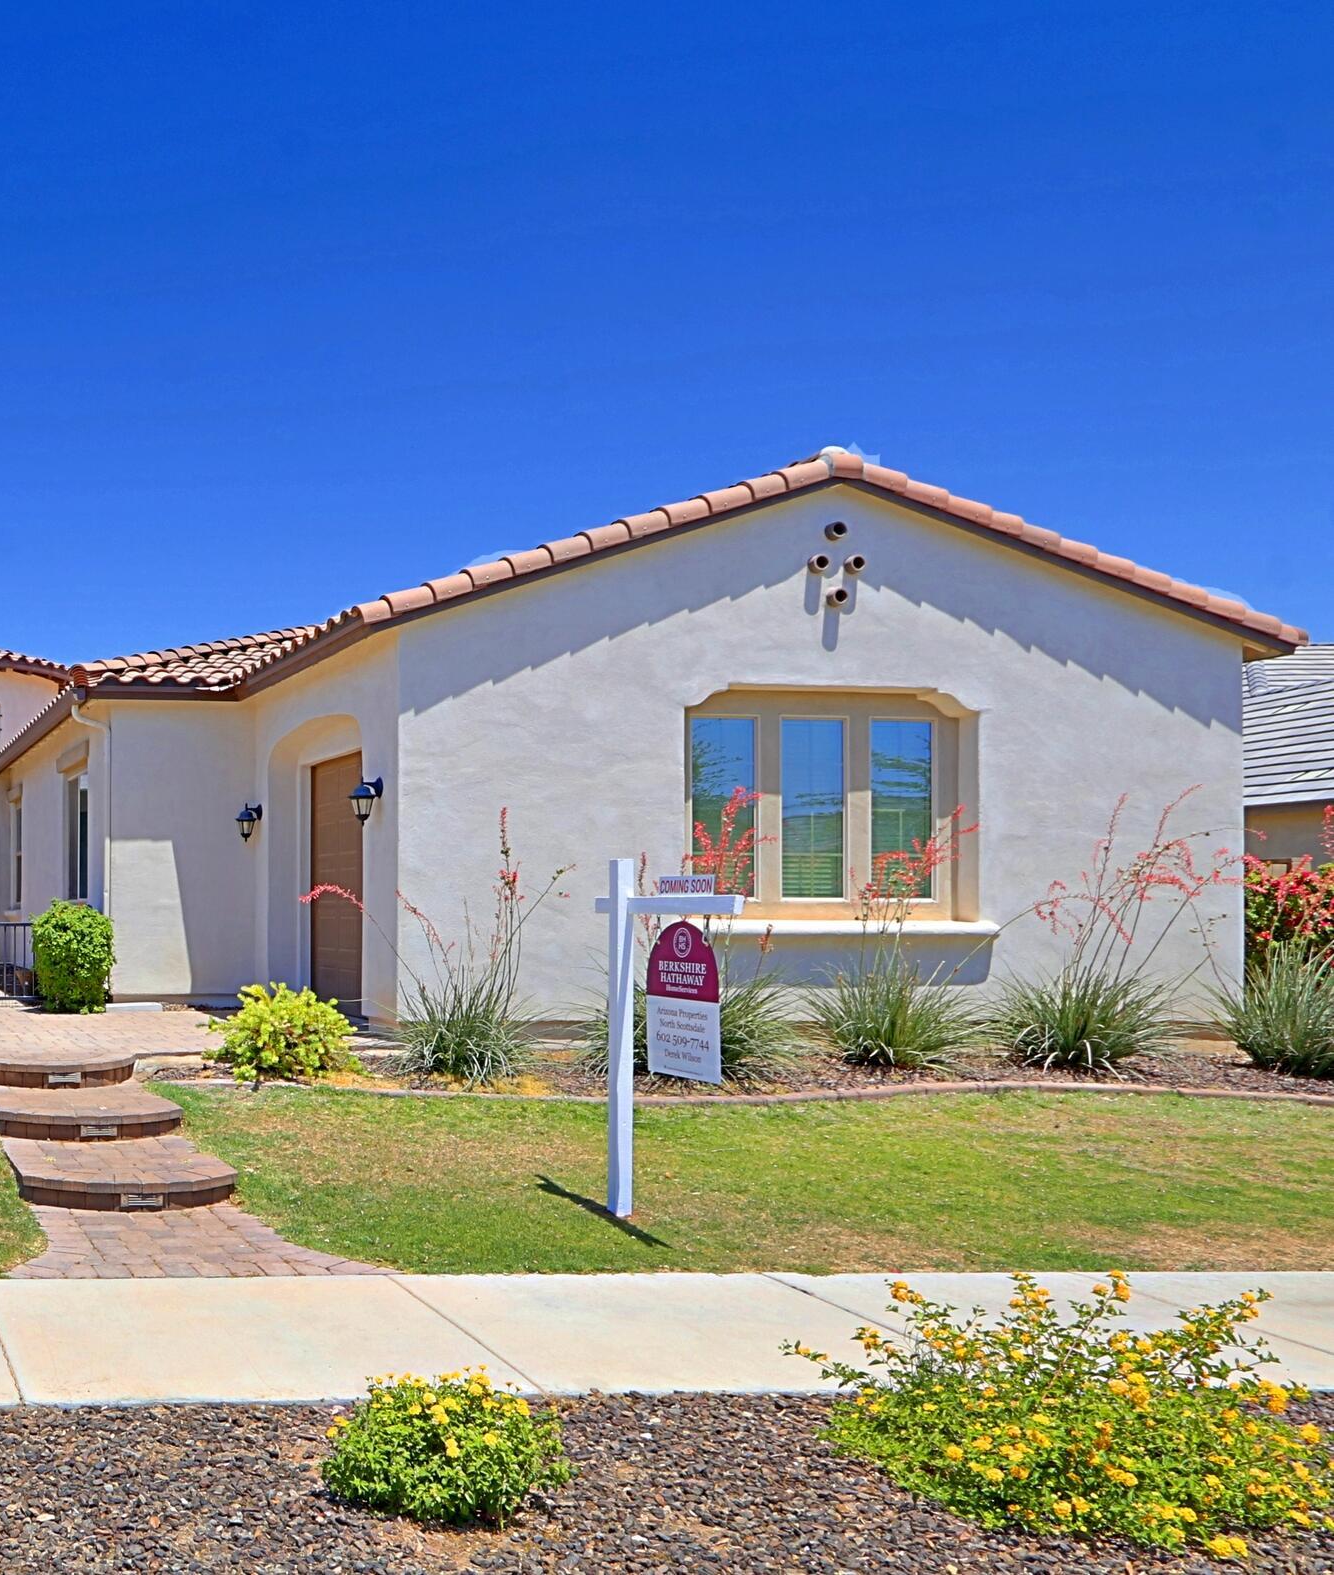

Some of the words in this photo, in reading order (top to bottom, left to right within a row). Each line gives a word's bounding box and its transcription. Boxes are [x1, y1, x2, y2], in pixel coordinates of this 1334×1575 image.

[660, 879, 689, 894] COMING
[691, 878, 712, 893] SOON
[658, 961, 707, 974] BERKSHIRE
[660, 972, 705, 986] HATHAWAY
[678, 1009, 708, 1021] Properties
[660, 1018, 676, 1029] North
[676, 1021, 705, 1033] Scottsdale
[656, 1031, 671, 1043] 602
[672, 1035, 709, 1051] 509-7744
[665, 1048, 681, 1060] Derek
[682, 1051, 701, 1063] Wilson
